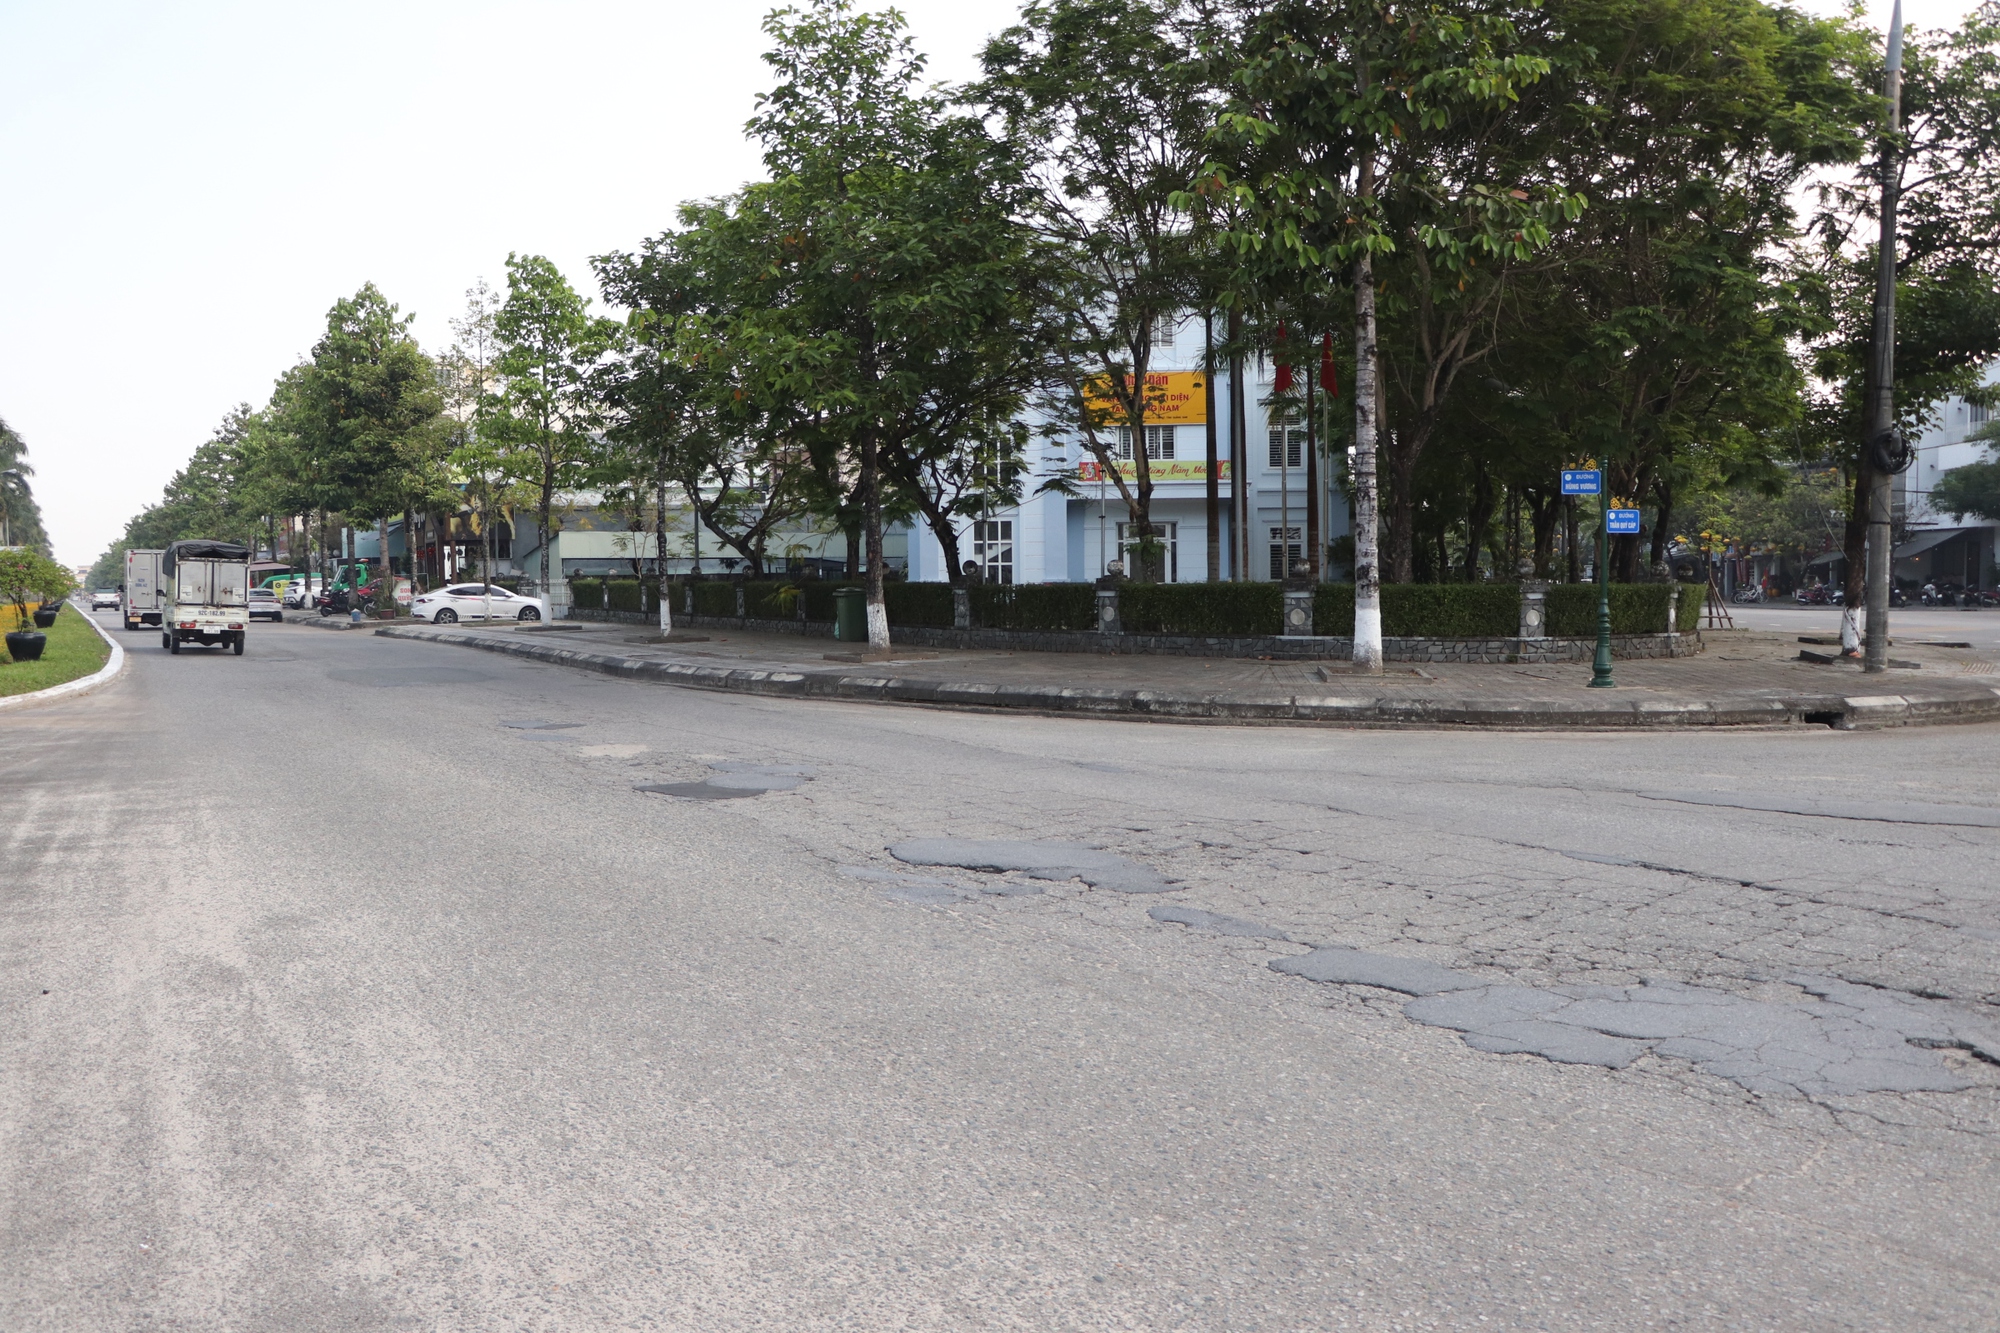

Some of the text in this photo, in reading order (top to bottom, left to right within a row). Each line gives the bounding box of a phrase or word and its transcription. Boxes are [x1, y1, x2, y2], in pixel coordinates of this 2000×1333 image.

[1170, 392, 1189, 403] DIỆN
[1159, 404, 1180, 412] NAM
[1565, 482, 1579, 490] HÙNG
